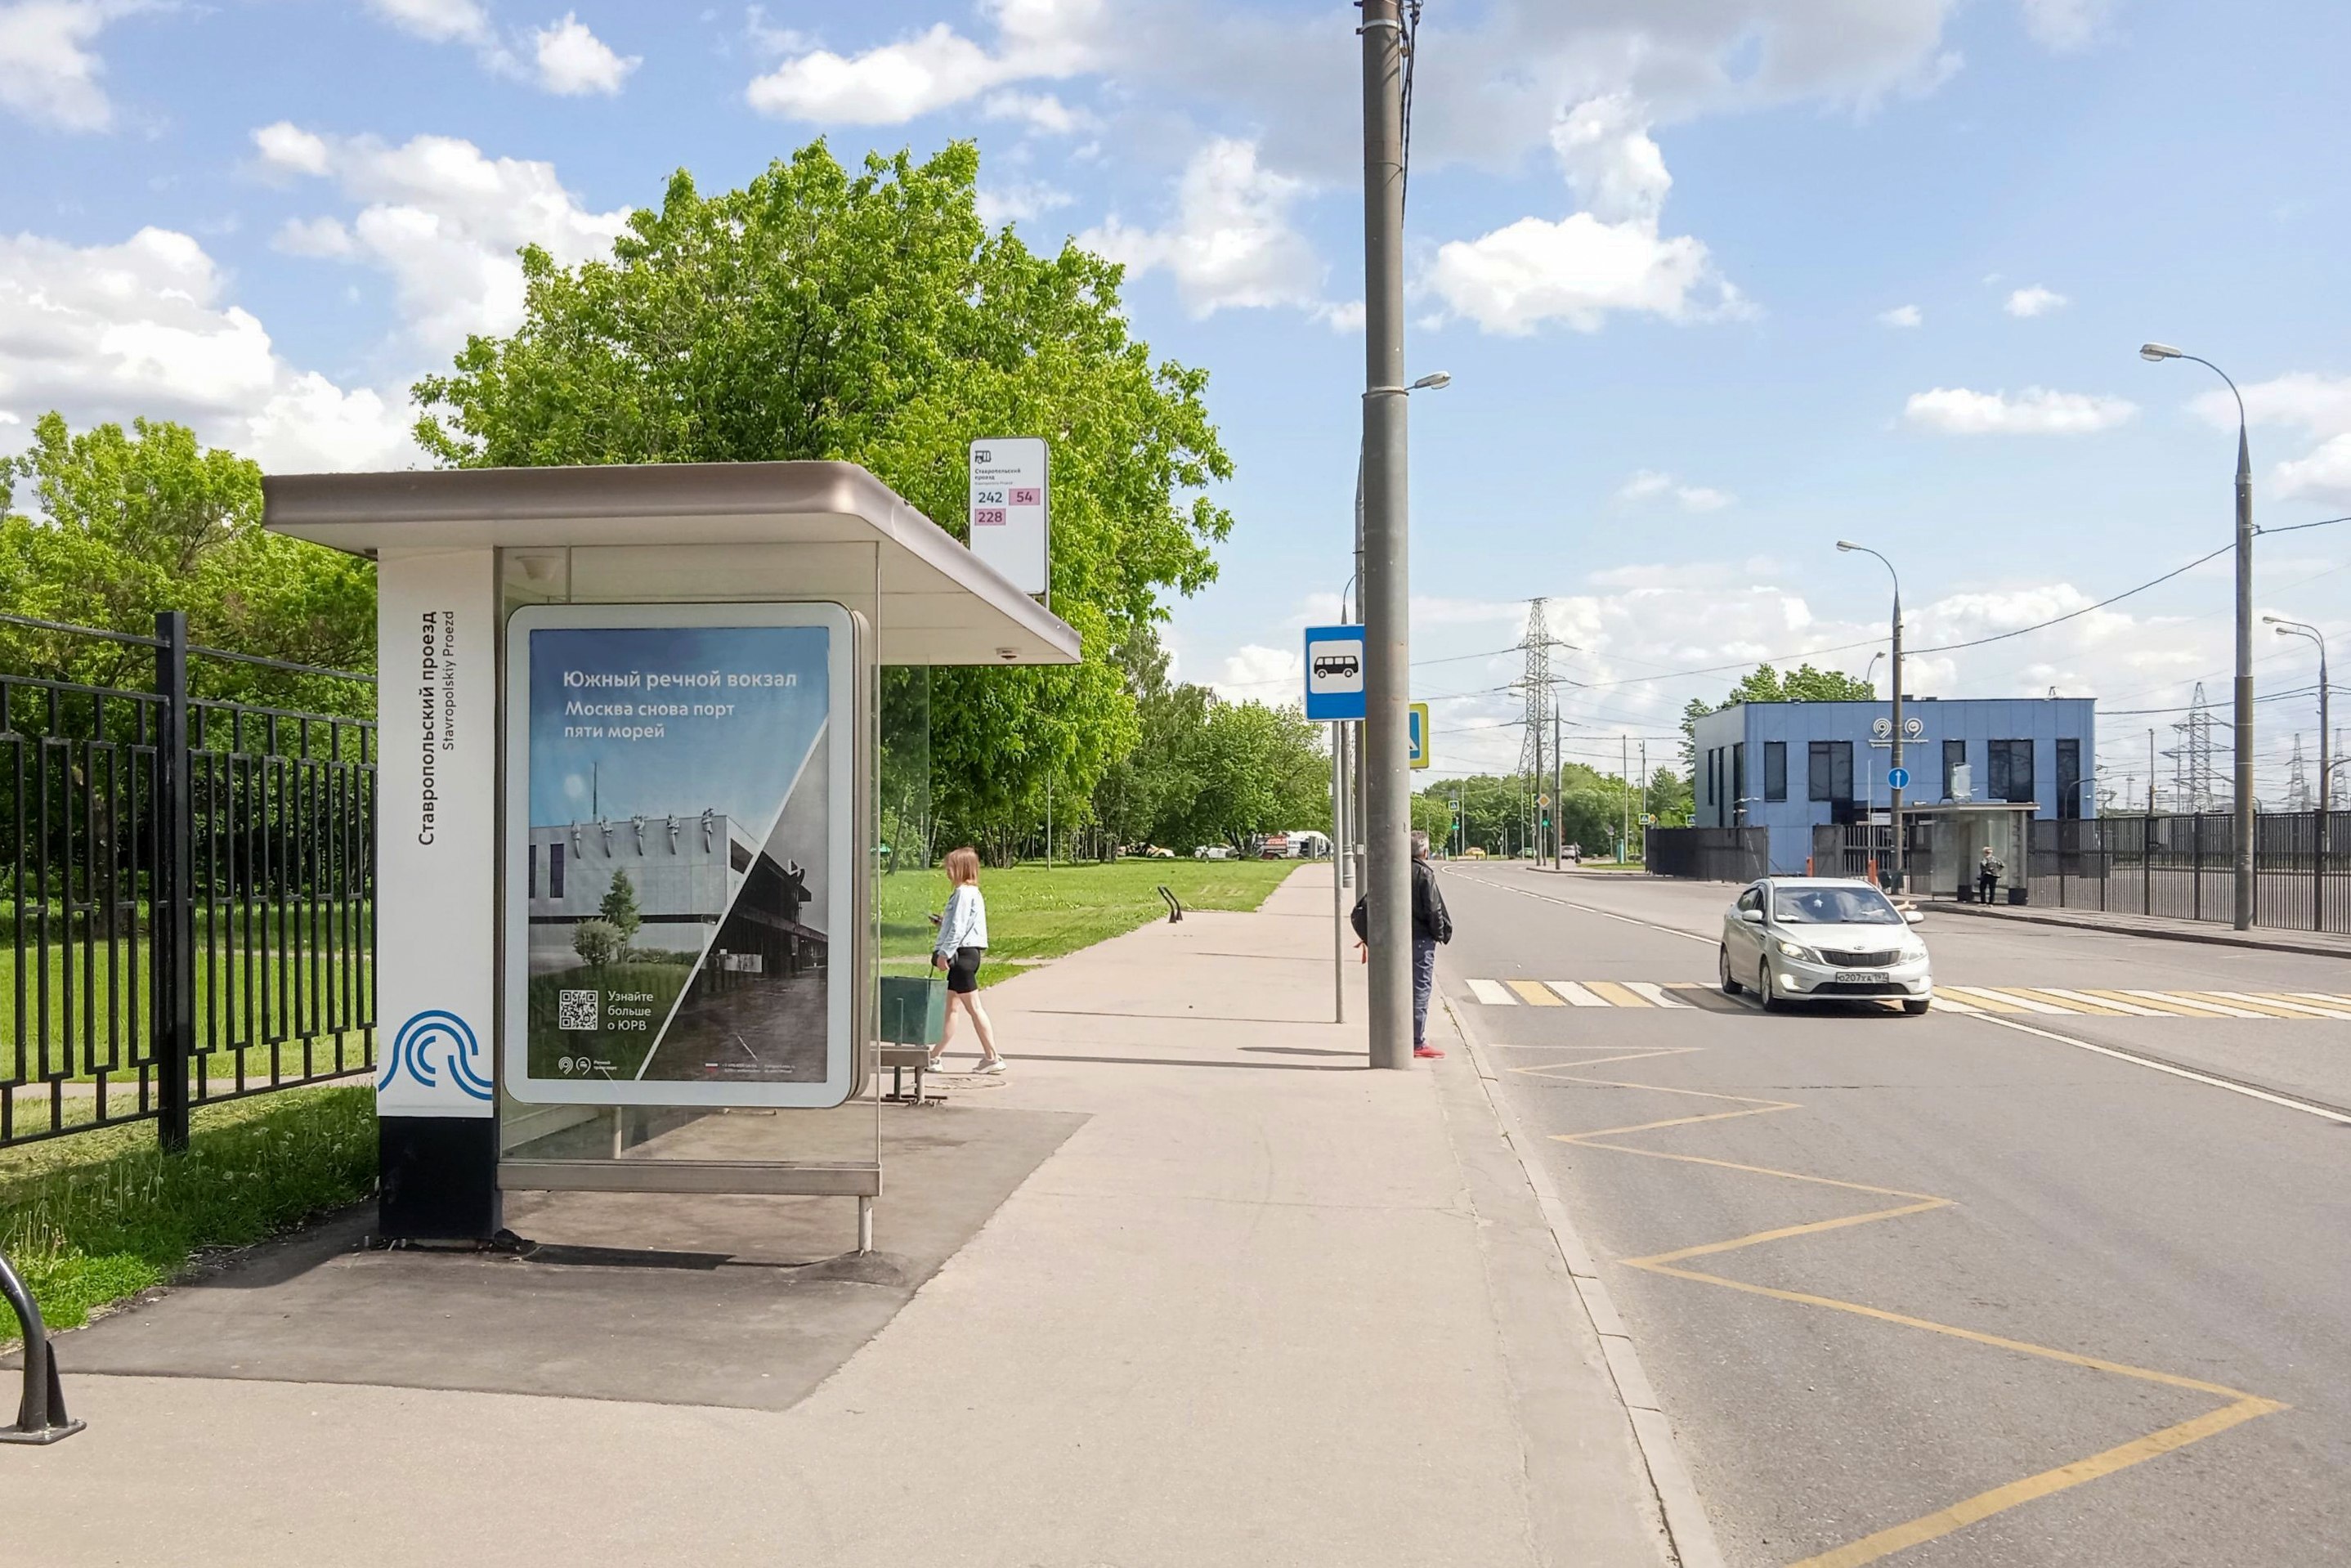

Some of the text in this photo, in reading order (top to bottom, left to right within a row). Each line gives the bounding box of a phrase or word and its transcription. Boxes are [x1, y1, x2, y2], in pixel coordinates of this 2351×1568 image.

[978, 491, 1033, 504] 242 54
[978, 511, 1003, 523] 228
[442, 611, 456, 751] Stavropolskiy Proezd
[563, 670, 798, 691] Южный речной вокзал
[565, 701, 735, 719] Москва снова порт
[418, 611, 438, 846] Ставропольский проезд
[564, 724, 665, 741] пяти морей
[607, 990, 654, 1002] Узнайте
[607, 1005, 652, 1017] больше
[607, 1019, 647, 1032] о ЮРВ
